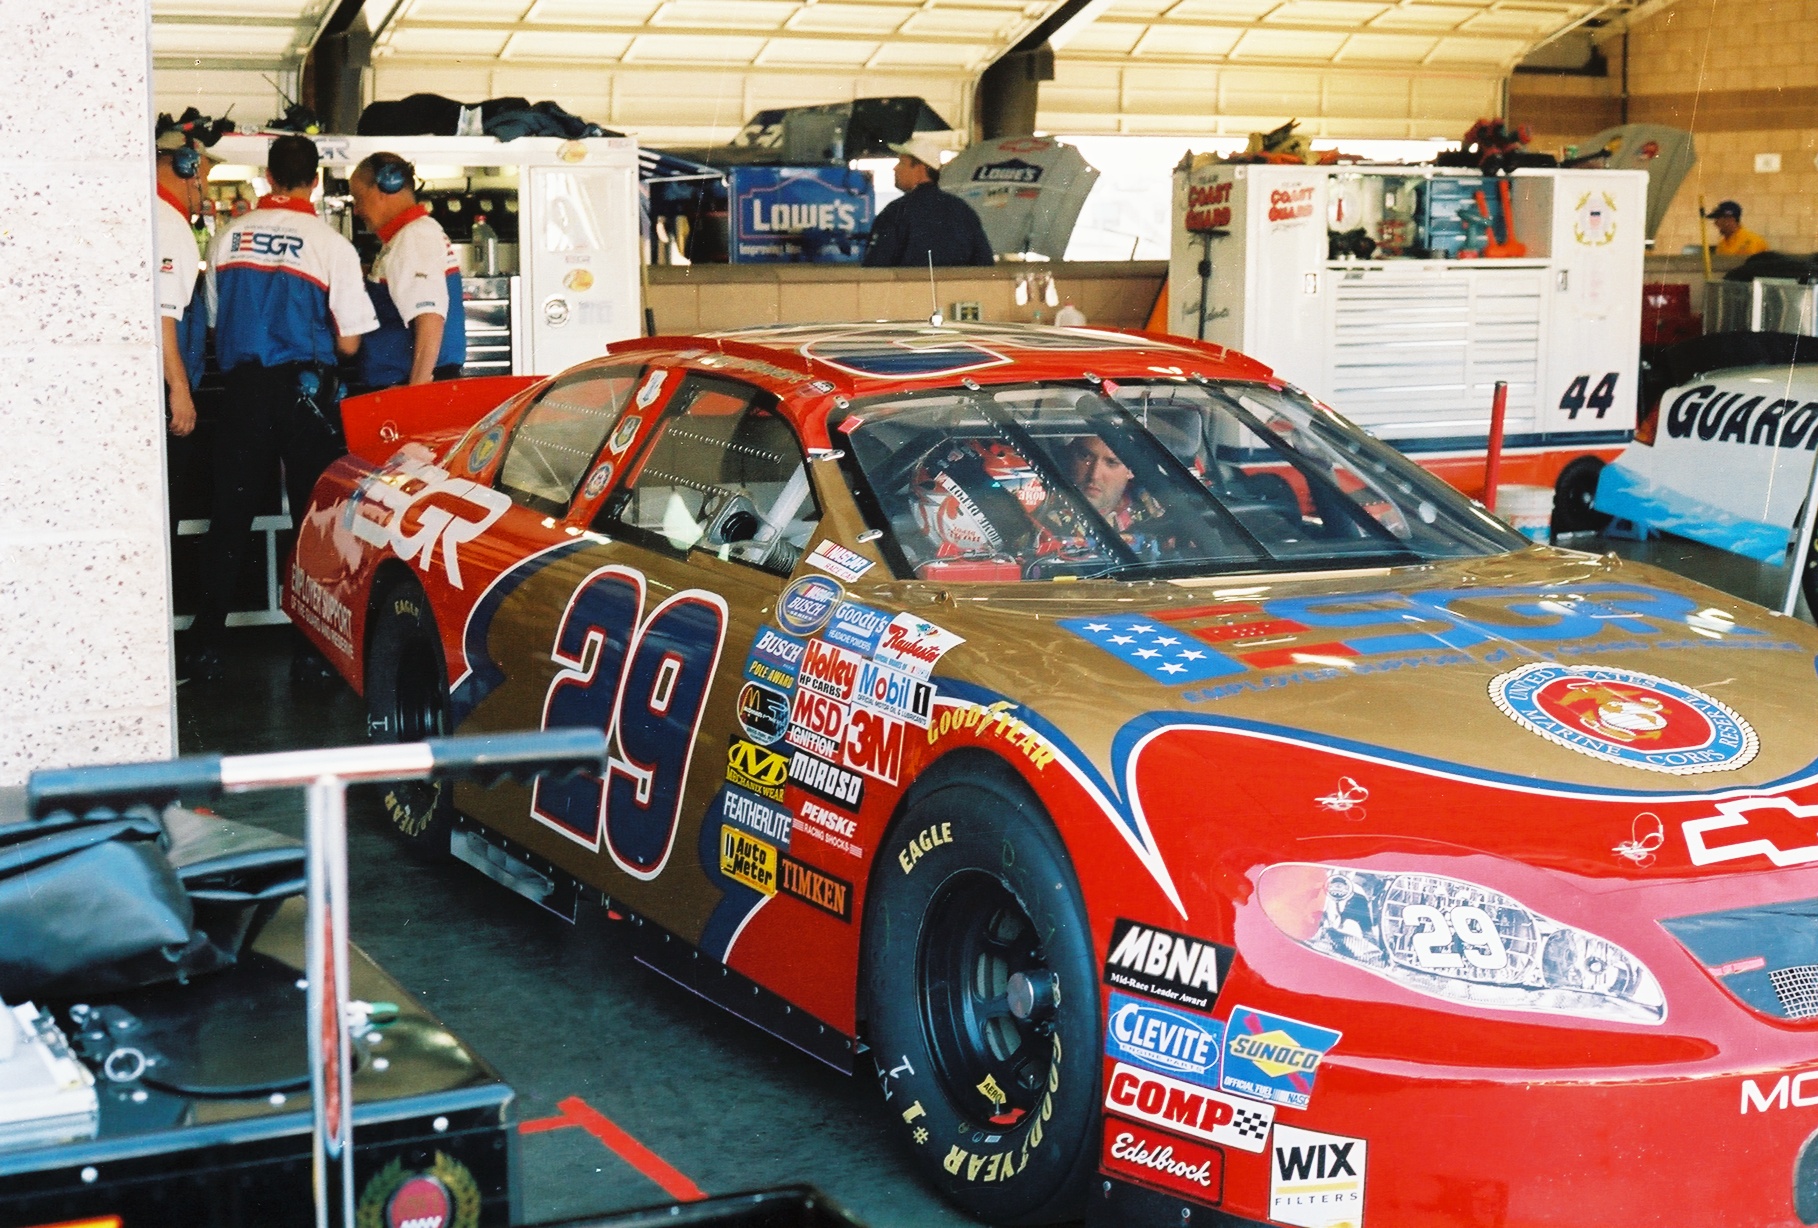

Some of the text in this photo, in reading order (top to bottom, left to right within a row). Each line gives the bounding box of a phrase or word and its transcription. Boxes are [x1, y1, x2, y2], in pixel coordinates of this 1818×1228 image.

[753, 199, 856, 231] LOWE'S
[1271, 187, 1315, 205] COAST
[1559, 372, 1620, 420] 44
[827, 543, 869, 572] NASCAR
[788, 597, 826, 617] BUSCH
[835, 601, 888, 633] Goody's
[755, 630, 803, 663] BUSCH
[882, 623, 941, 664] Raybestos
[749, 660, 794, 689] POLE AWARD
[800, 673, 842, 698] HP CARBS
[801, 640, 858, 700] Holley
[859, 663, 911, 709] Mobil
[530, 564, 729, 882] 29
[792, 690, 842, 738] MSD
[789, 725, 836, 758] IGNITION
[848, 709, 902, 782] 3M
[927, 700, 1056, 771] GOODYEAR
[1522, 709, 1725, 766] MARINE CORPS
[725, 765, 785, 803] MECHANIX WEAR
[788, 751, 863, 805] MOROSO
[723, 790, 791, 844] FEATHERLITE
[800, 801, 858, 839] PENSKE
[735, 837, 767, 865] Auto
[803, 823, 850, 852] RACING SHOCKS
[898, 822, 954, 875] EAGLE
[734, 853, 772, 886] Meter
[781, 858, 846, 915] TIMKEN
[1402, 904, 1510, 970] 29
[1107, 925, 1219, 994] MBNA
[1110, 973, 1208, 1007] Mid-Race Leader Award
[1115, 1003, 1213, 1064] CLEVITE
[1233, 1036, 1320, 1069] SUNOCO
[983, 1082, 1003, 1101] AERO
[1110, 1072, 1234, 1133] COMP
[1224, 1075, 1273, 1096] OFFICIAL FUEL
[1110, 1132, 1212, 1187] Edelbrock
[1275, 1142, 1358, 1181] WIX
[1275, 1192, 1358, 1206] FILTERS
